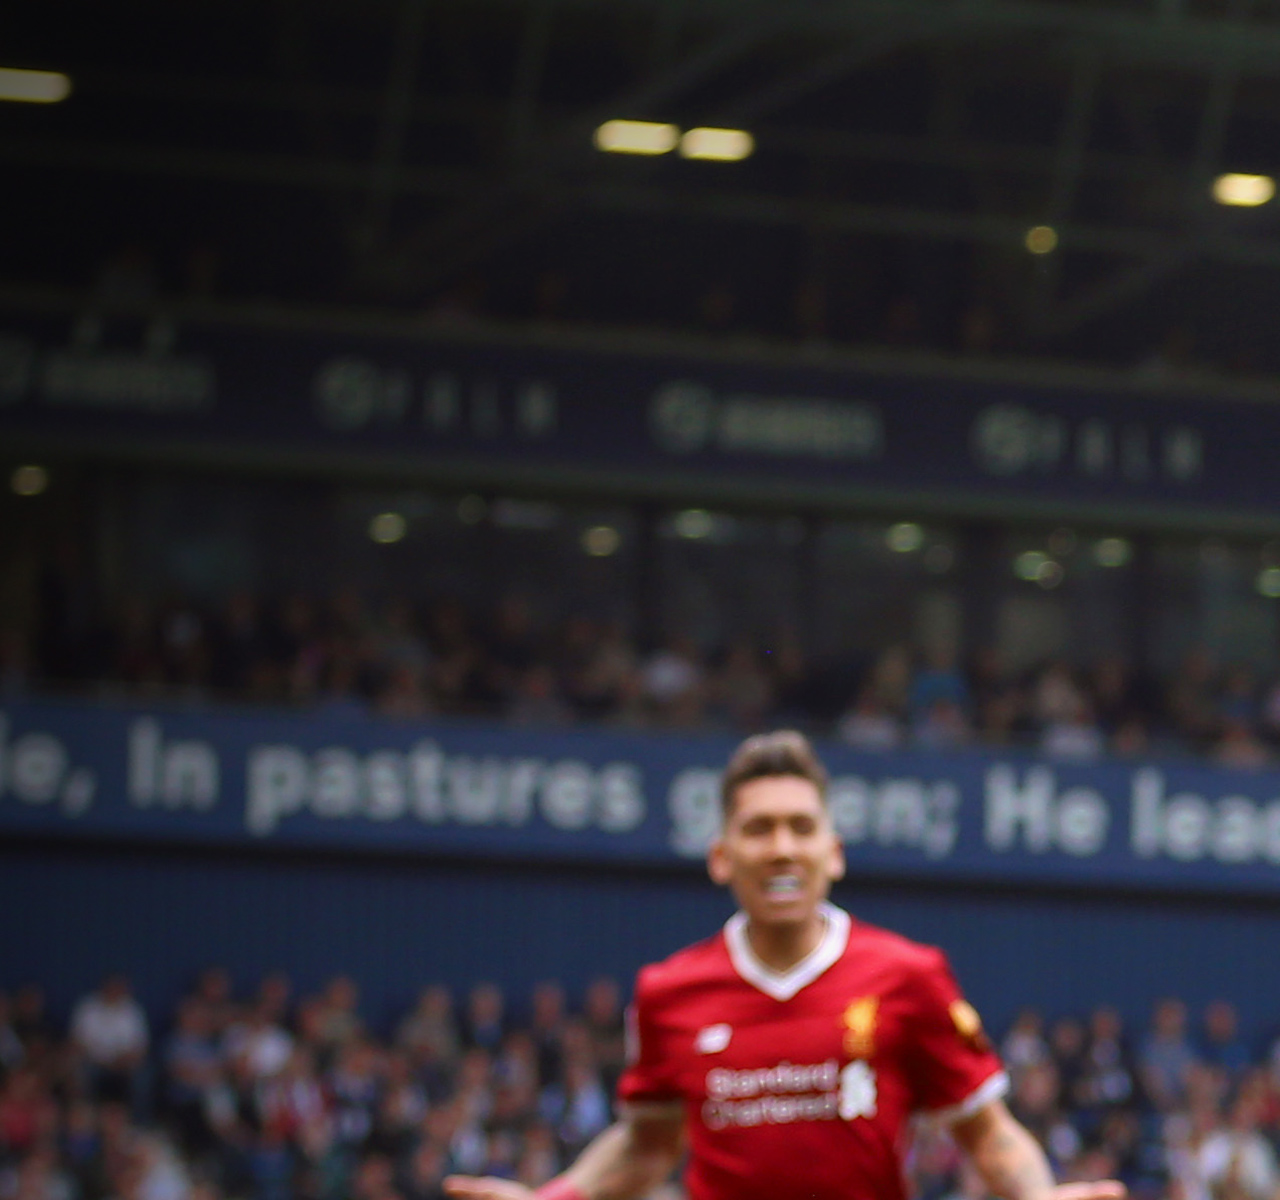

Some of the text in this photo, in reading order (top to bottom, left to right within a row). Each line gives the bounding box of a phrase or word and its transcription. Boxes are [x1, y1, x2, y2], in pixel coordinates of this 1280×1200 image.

[129, 715, 220, 808] In
[247, 738, 647, 837] pastures
[669, 765, 962, 859] gen;
[984, 764, 1110, 857] He
